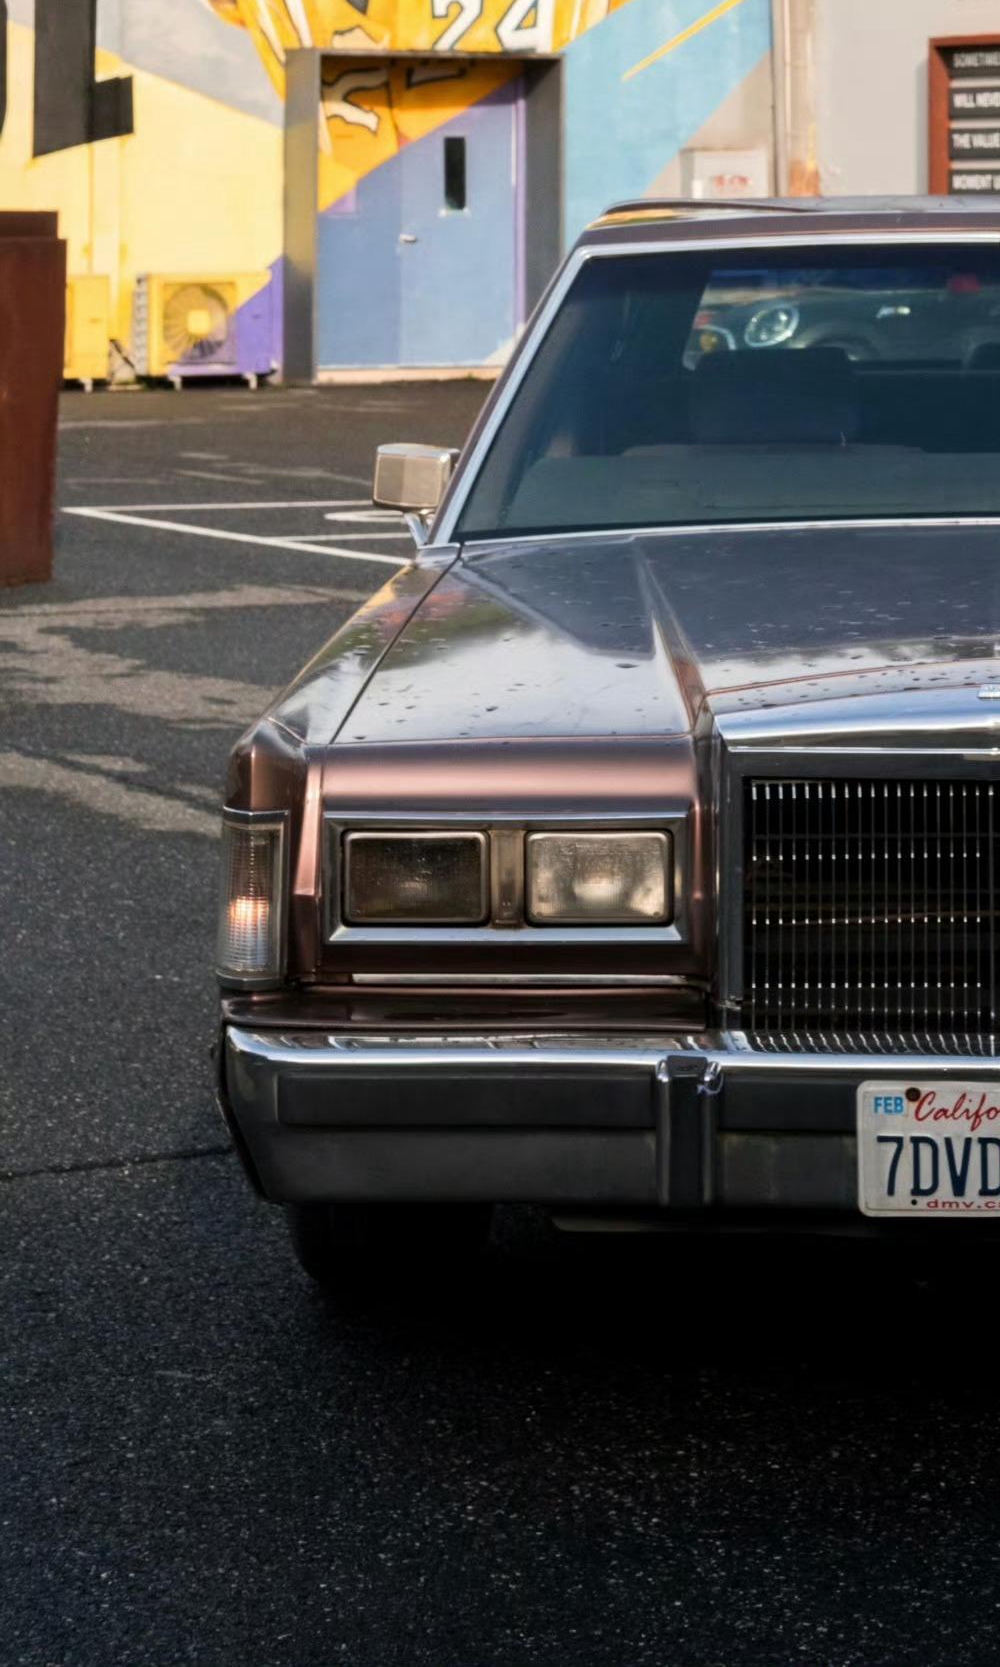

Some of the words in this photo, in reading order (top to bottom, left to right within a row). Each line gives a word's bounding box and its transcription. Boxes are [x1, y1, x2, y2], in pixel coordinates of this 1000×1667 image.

[953, 93, 976, 108] WILL
[952, 133, 971, 149] THE
[874, 1096, 904, 1114] FEB
